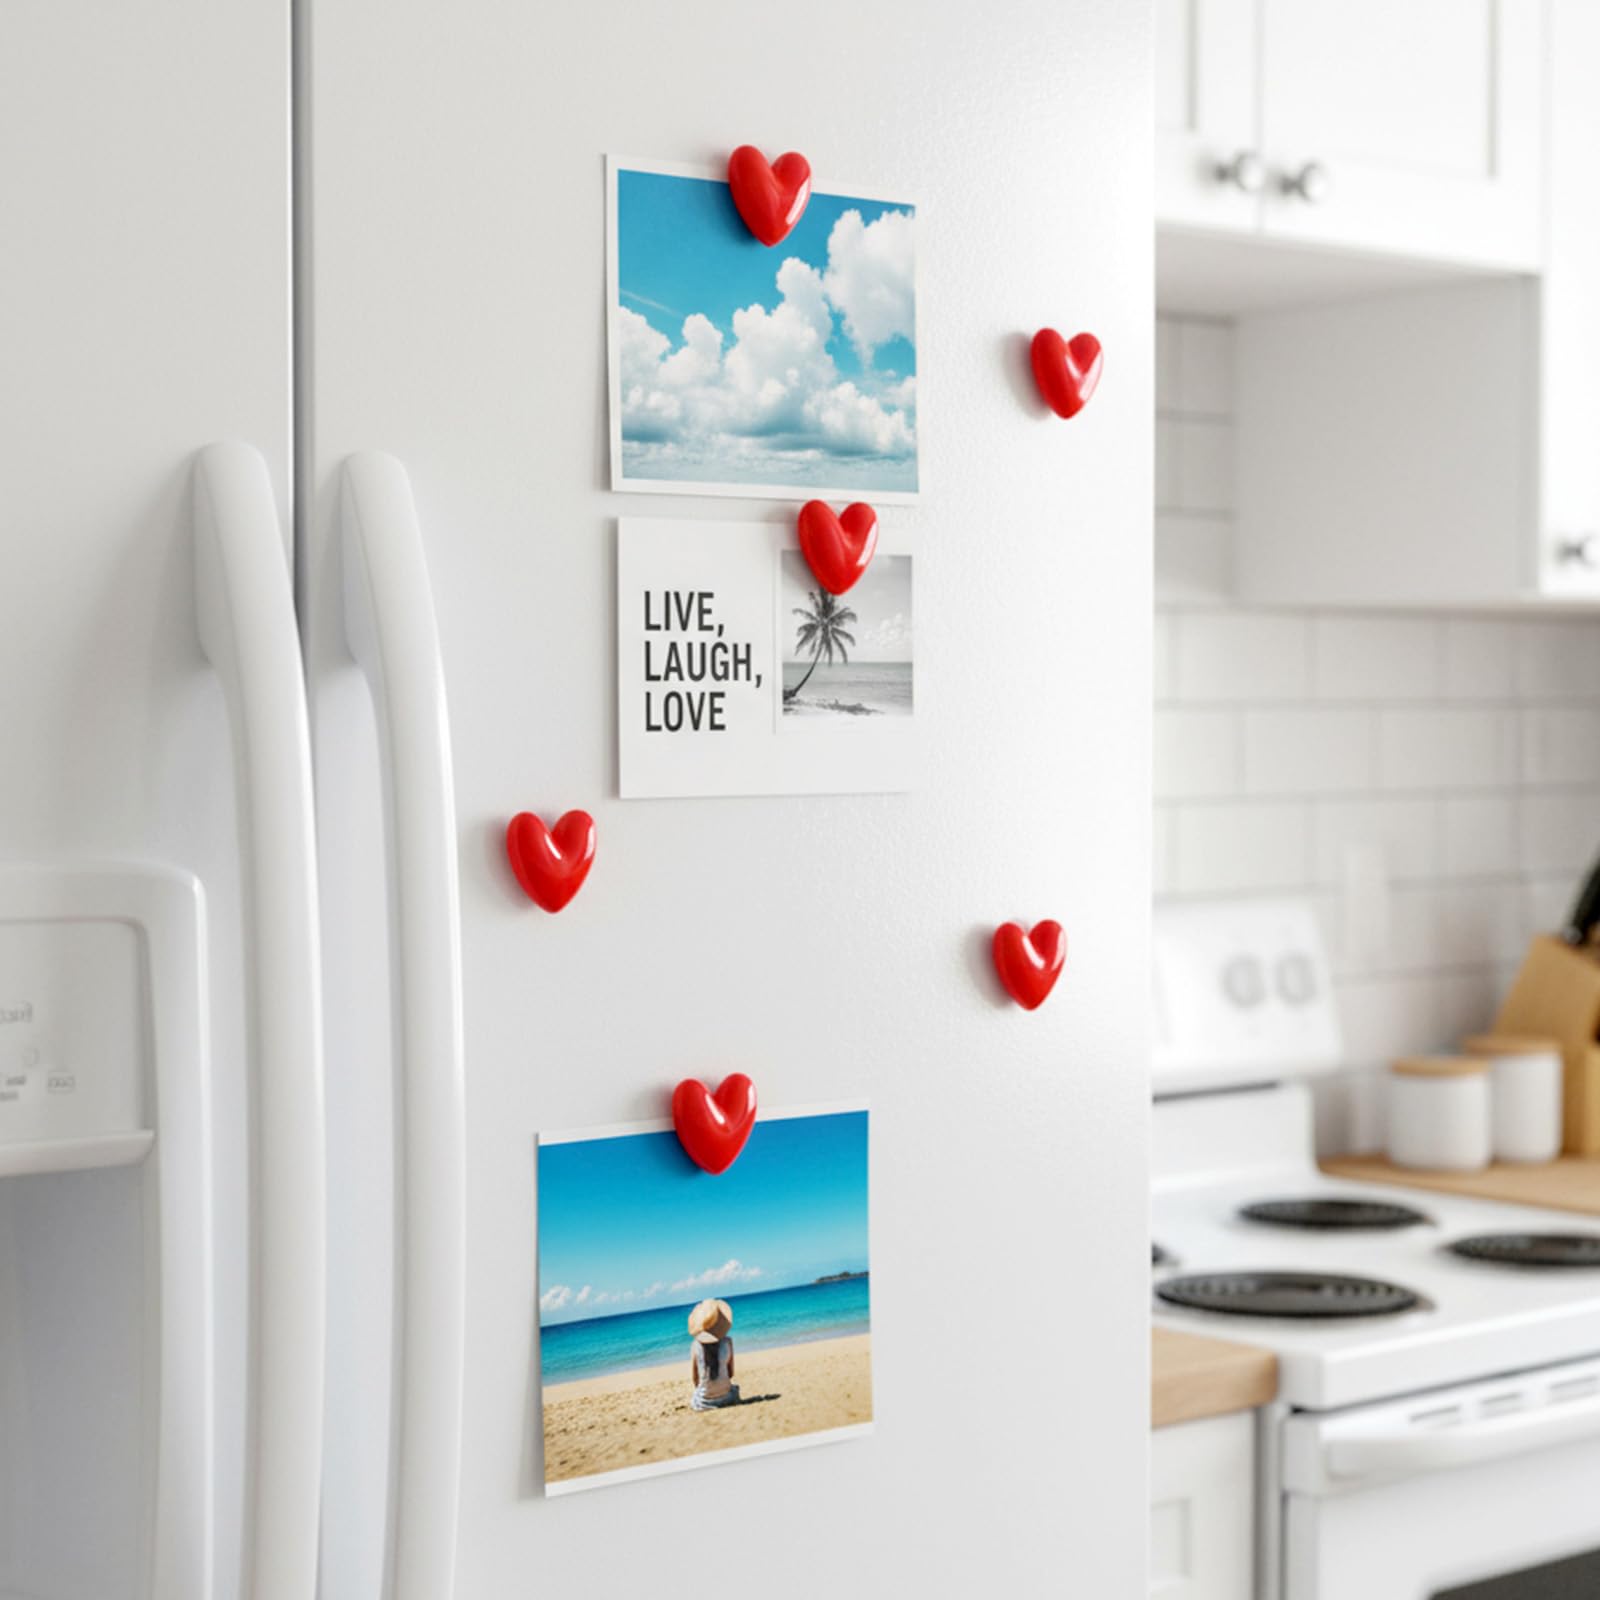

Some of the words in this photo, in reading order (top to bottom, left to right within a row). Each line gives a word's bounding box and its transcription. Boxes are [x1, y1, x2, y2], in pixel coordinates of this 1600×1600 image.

[644, 590, 724, 638] LIVE,
[644, 640, 762, 689] LAUGH,
[645, 690, 726, 733] LOVE
